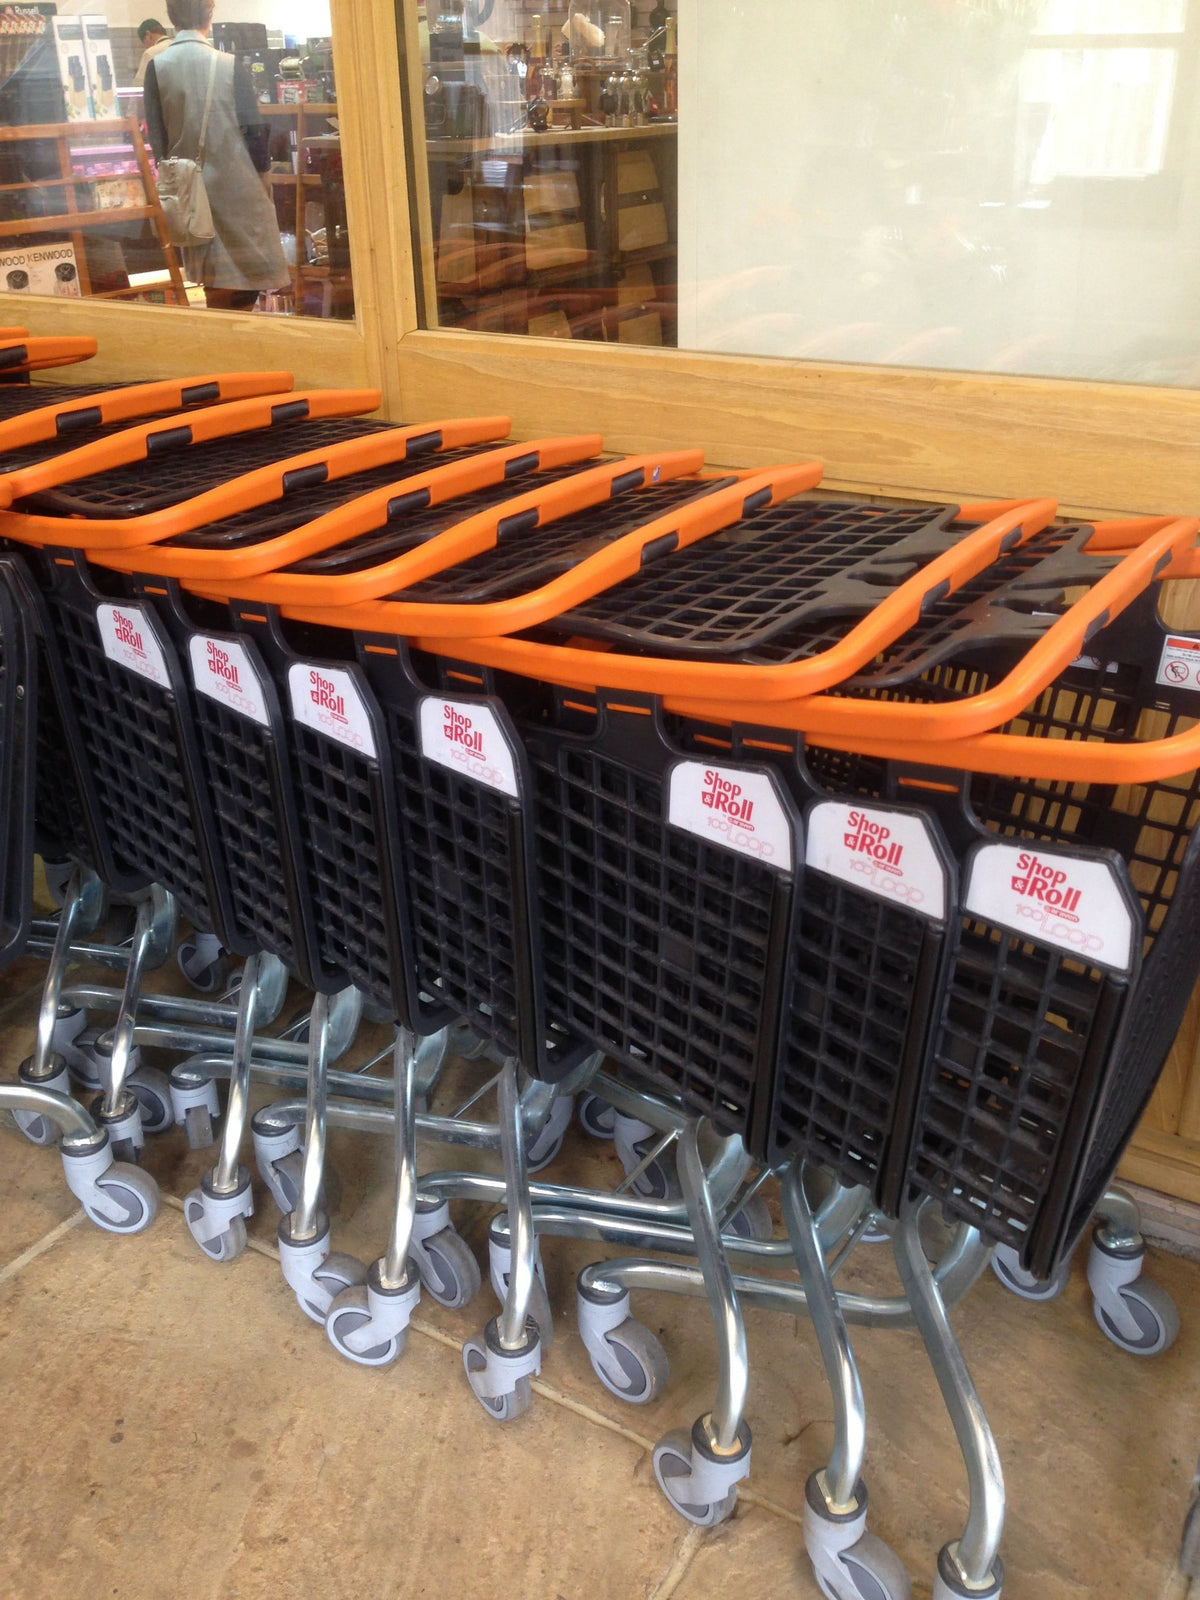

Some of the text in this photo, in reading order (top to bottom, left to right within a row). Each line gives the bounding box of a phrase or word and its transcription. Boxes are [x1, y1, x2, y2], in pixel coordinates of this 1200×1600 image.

[14, 6, 40, 15] Russell
[26, 248, 73, 263] KENWOOD
[112, 609, 133, 633] Shop
[206, 641, 229, 667] Shop
[310, 670, 335, 698] Shop
[443, 704, 472, 733] Shop
[703, 770, 742, 801] Shop
[847, 811, 891, 844] Shop
[1016, 853, 1067, 888] Shop
